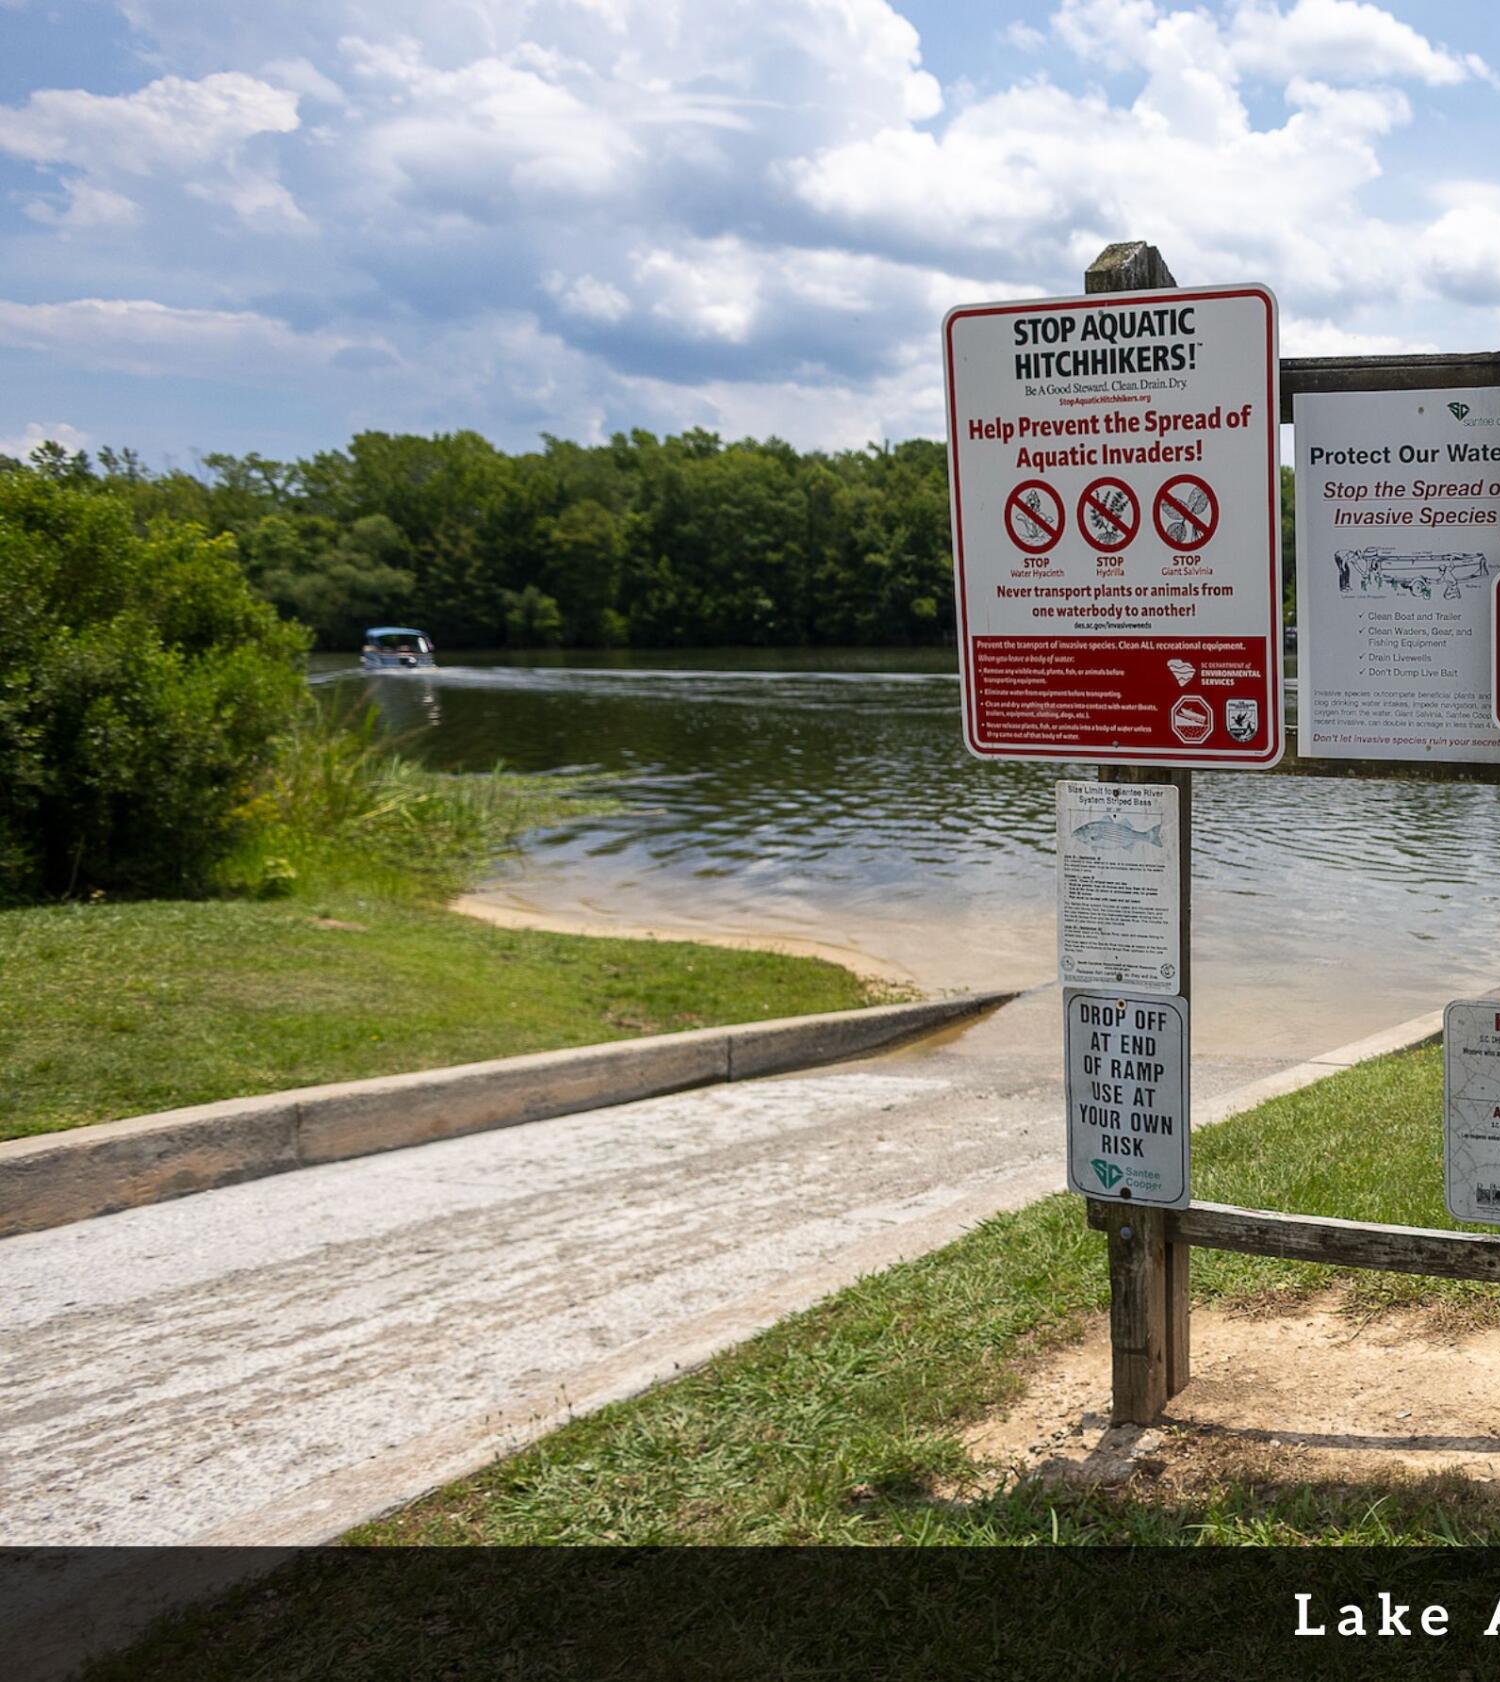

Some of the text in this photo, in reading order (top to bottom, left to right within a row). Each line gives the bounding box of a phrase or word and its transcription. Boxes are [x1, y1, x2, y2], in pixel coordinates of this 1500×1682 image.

[1014, 308, 1194, 346] STOP AQUATIC
[1026, 386, 1036, 396] Be
[1038, 386, 1046, 395] A
[1046, 384, 1071, 394] Good
[1073, 382, 1109, 393] Steward.
[1112, 380, 1139, 391] Clean.
[1140, 378, 1168, 390] Drain.
[969, 405, 1252, 444] Help Prevent the Spread of
[1017, 440, 1202, 473] Aquatic Invaders!
[1311, 447, 1390, 464] Protect
[1399, 445, 1440, 463] Our
[1324, 482, 1368, 498] Stop
[1375, 481, 1405, 497] the
[1412, 480, 1482, 500] Spread
[1335, 507, 1497, 528] Invasive Species
[1024, 558, 1049, 568] STOP
[1097, 557, 1123, 566] STOP
[1173, 556, 1200, 566] STOP
[1033, 569, 1064, 579] Hyacinth
[1096, 568, 1124, 578] Hydrilla
[1162, 567, 1212, 576] Giant Salvinia
[997, 583, 1232, 600] Never transport plants or animals from
[1032, 604, 1195, 619] one waterbody to another!
[1368, 612, 1392, 620] Clean
[1395, 612, 1414, 620] Boat
[1369, 653, 1432, 662] Drain Livewells
[1313, 734, 1338, 742] Don't
[1340, 734, 1352, 742] let
[1354, 735, 1390, 744] invasive
[1393, 736, 1426, 745] species
[1449, 739, 1470, 747] your
[1080, 1004, 1166, 1031] DROP OFF
[1091, 1032, 1155, 1056] AT END
[1084, 1055, 1164, 1082] OF RAMP
[1092, 1081, 1155, 1107] USE AT
[1080, 1104, 1172, 1135] YOUR OWN
[1102, 1134, 1144, 1157] RISK
[1126, 1167, 1160, 1180] Santee
[1126, 1178, 1162, 1192] Cooper
